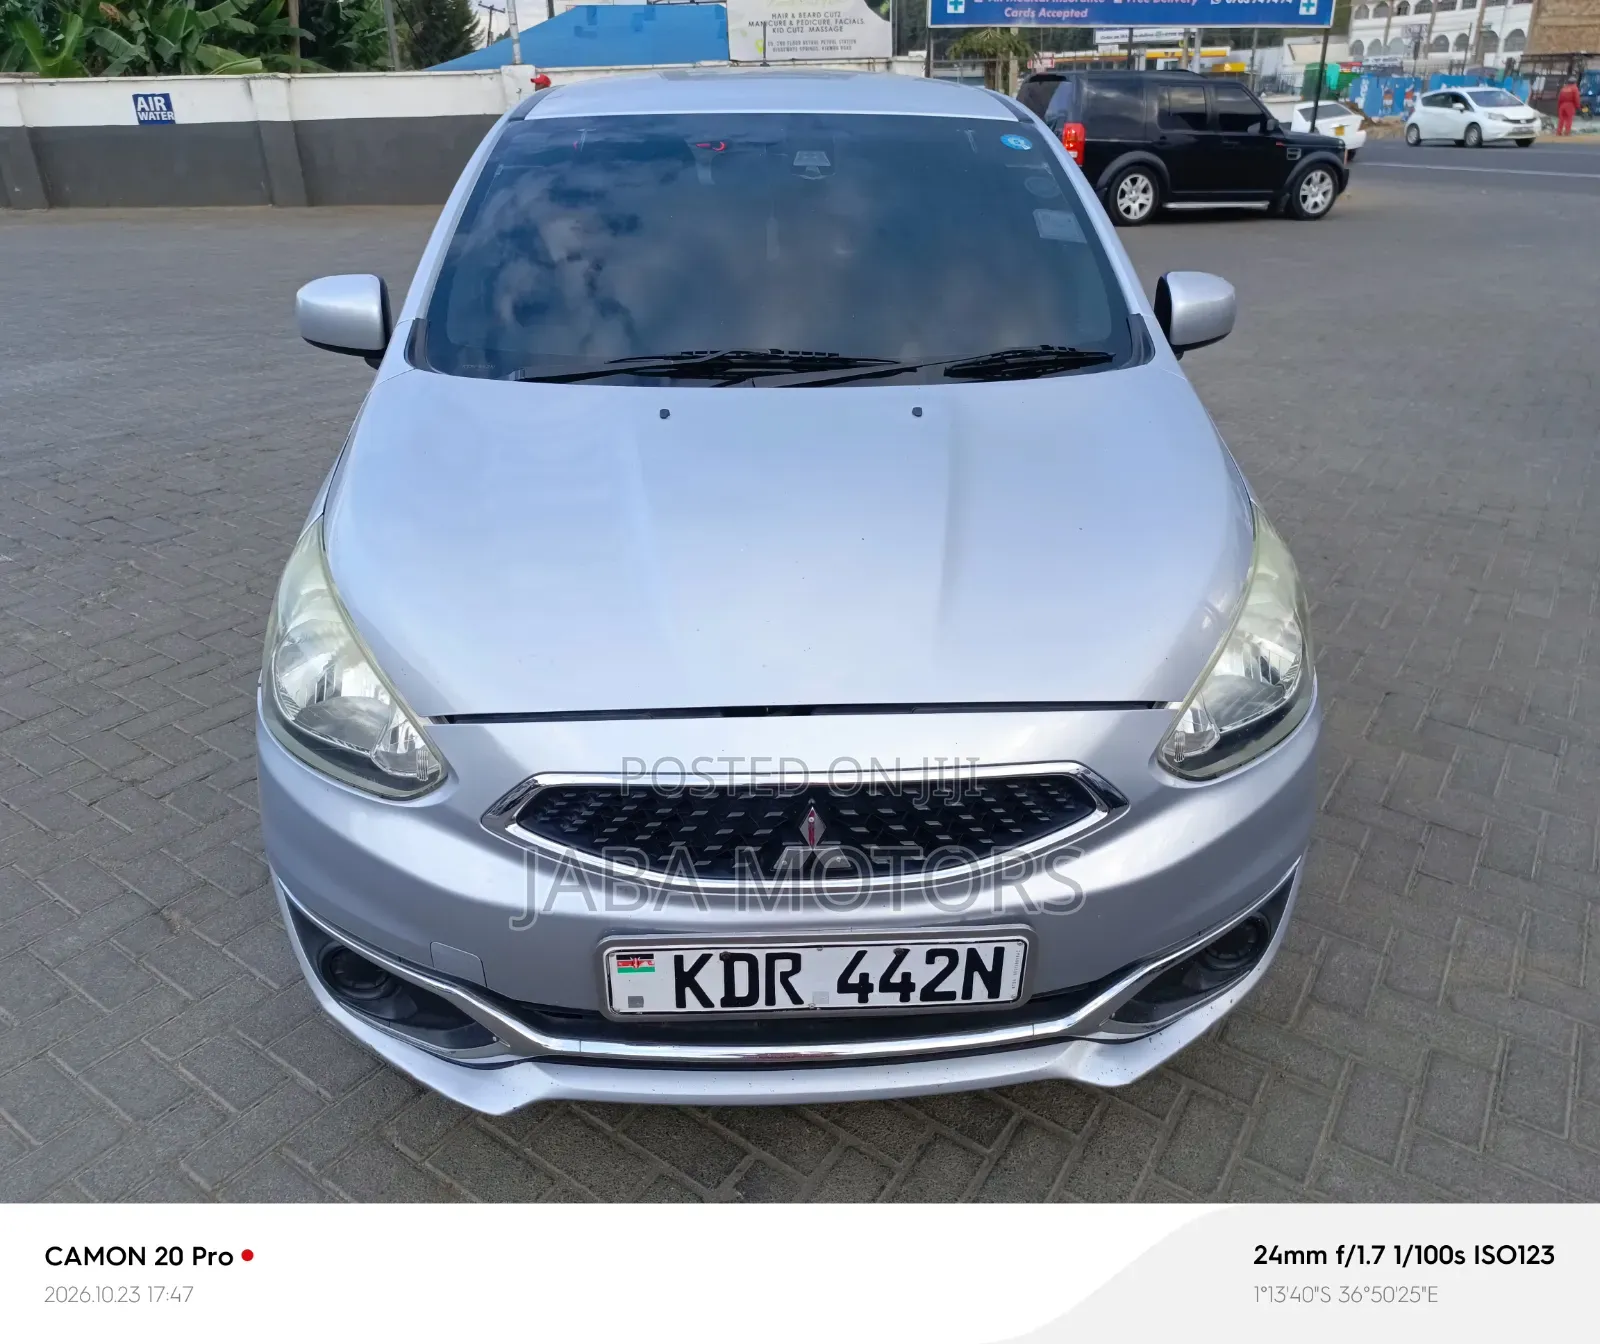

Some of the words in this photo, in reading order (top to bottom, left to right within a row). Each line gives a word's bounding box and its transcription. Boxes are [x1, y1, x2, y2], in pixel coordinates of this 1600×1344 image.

[771, 12, 788, 20] HAIR
[798, 11, 822, 19] BEARD
[1004, 7, 1036, 18] Cards
[1038, 8, 1089, 20] Accepted
[808, 25, 844, 33] MASSAGE
[137, 96, 167, 111] AIR
[137, 111, 175, 121] WATER
[673, 952, 805, 1009] KDR
[836, 946, 1005, 1004] 442N
